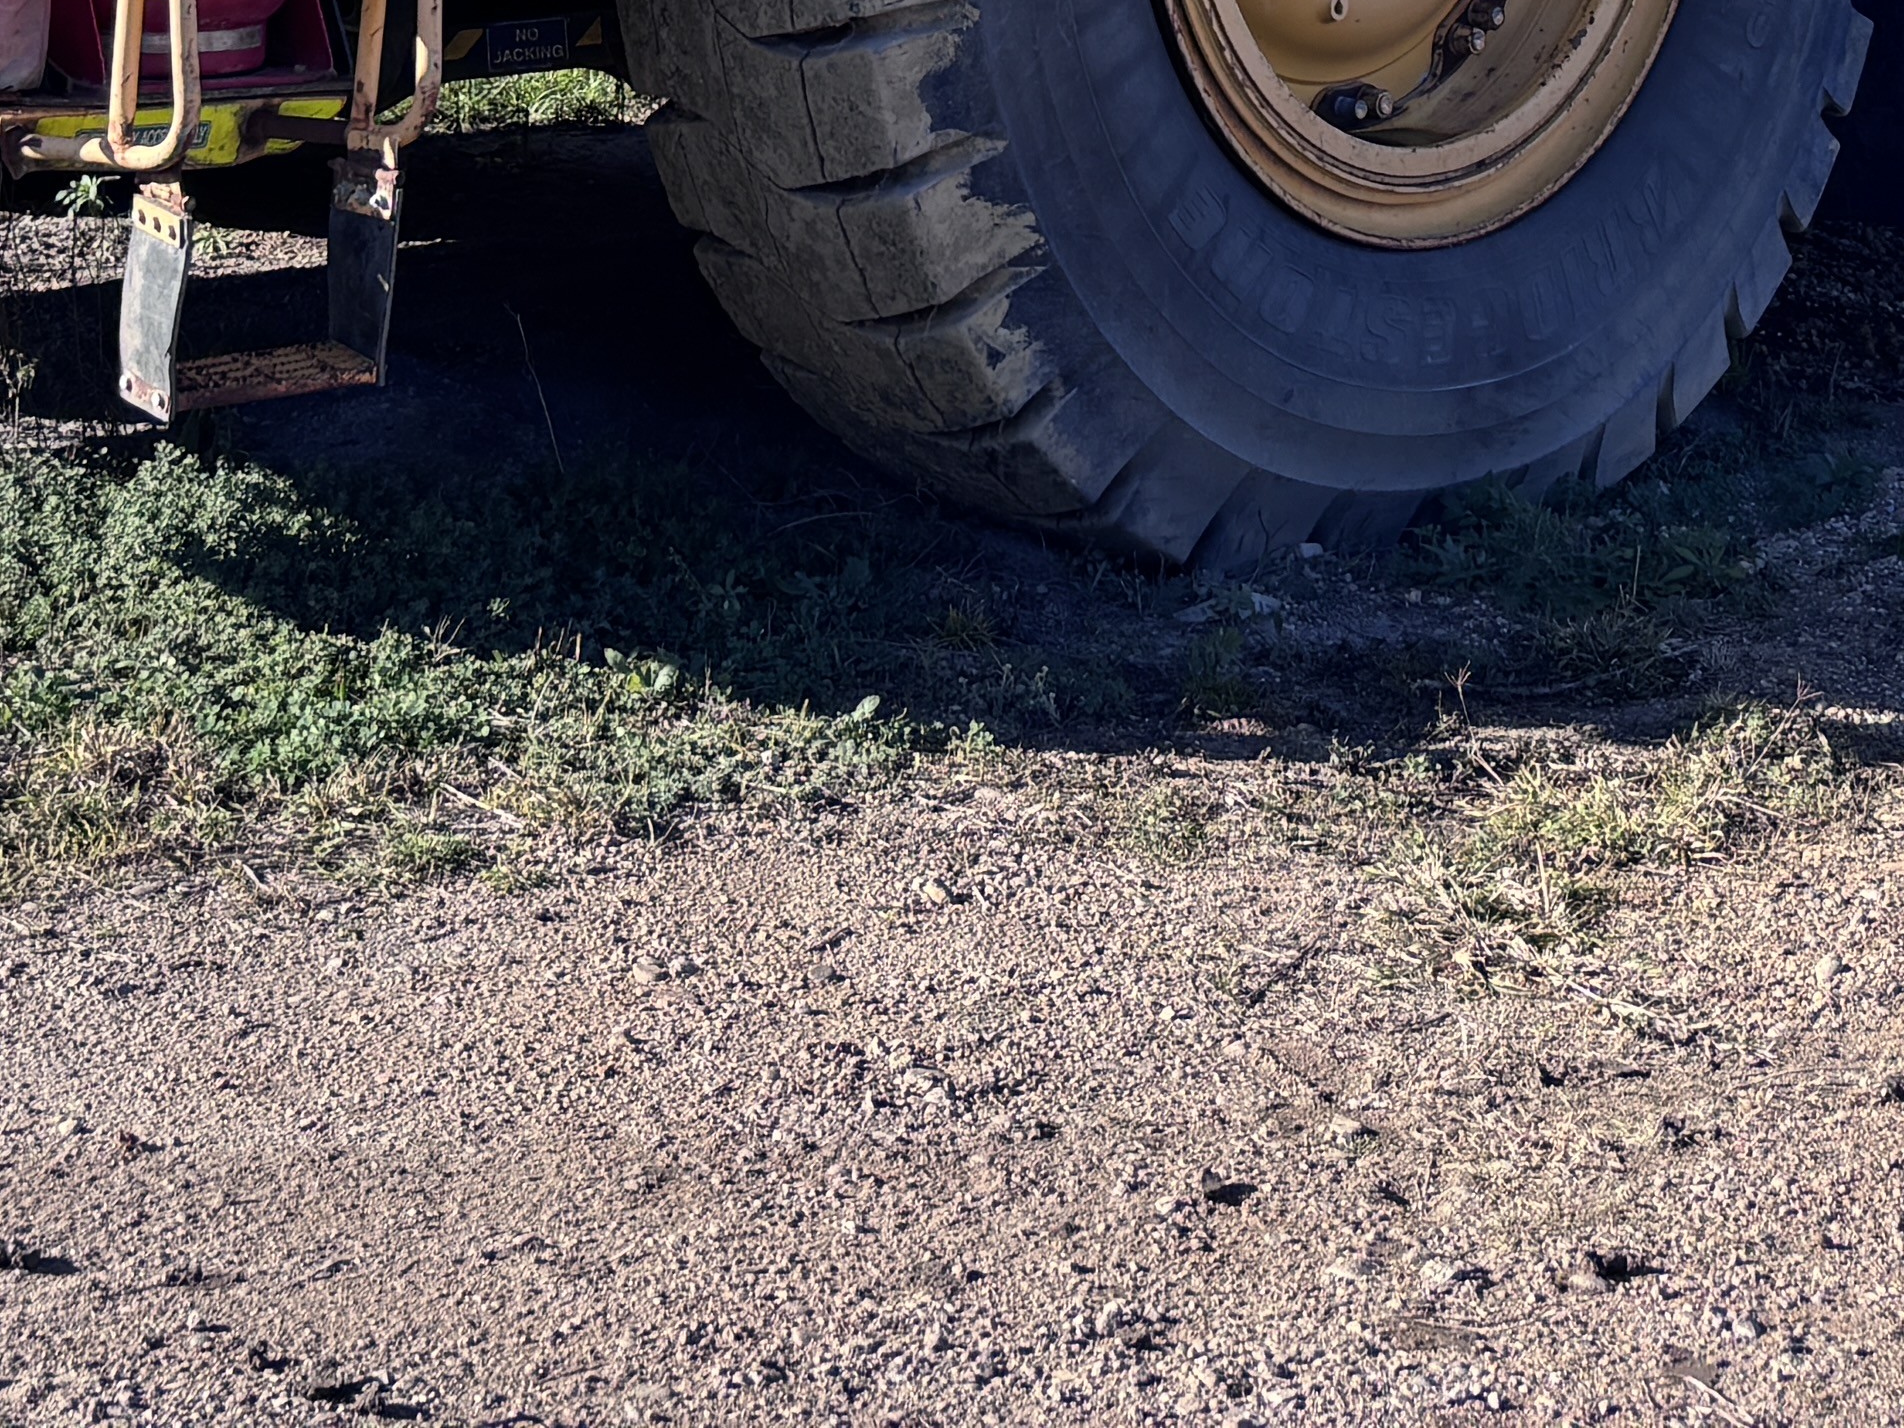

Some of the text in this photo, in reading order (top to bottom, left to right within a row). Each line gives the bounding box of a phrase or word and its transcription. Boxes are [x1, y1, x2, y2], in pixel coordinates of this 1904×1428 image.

[515, 28, 539, 42] NO
[494, 44, 564, 64] JACKING
[1167, 166, 1689, 366] BRIDGESTONE
